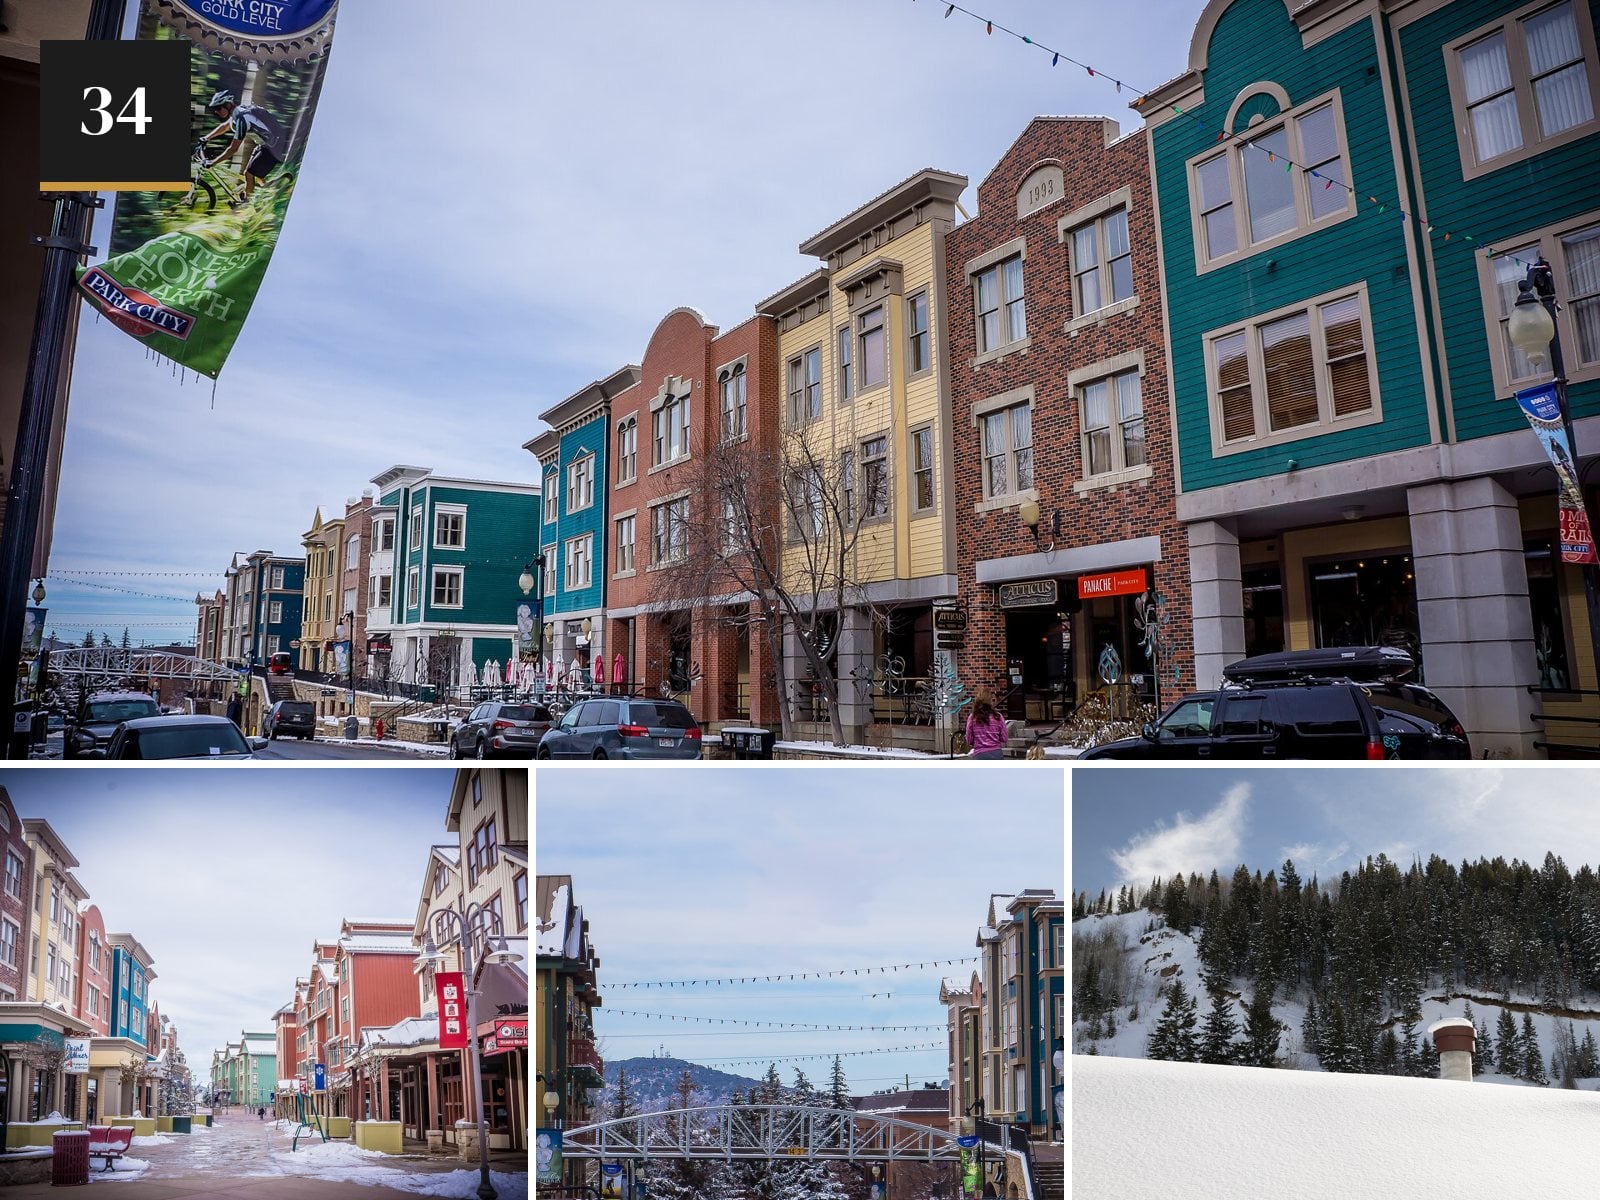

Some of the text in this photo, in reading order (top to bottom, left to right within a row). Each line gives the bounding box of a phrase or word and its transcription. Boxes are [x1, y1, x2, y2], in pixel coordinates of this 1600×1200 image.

[201, 1, 282, 31] GOLD LEVEL
[249, 1, 284, 18] CITY
[1028, 180, 1054, 205] 1993
[128, 262, 236, 322] EARTH
[86, 273, 136, 313] PARK
[136, 304, 188, 333] CITY
[1568, 521, 1580, 530] OF
[1003, 581, 1051, 599] ATTICUS
[1083, 577, 1112, 594] PANACHE
[938, 612, 965, 621] ATTICUS
